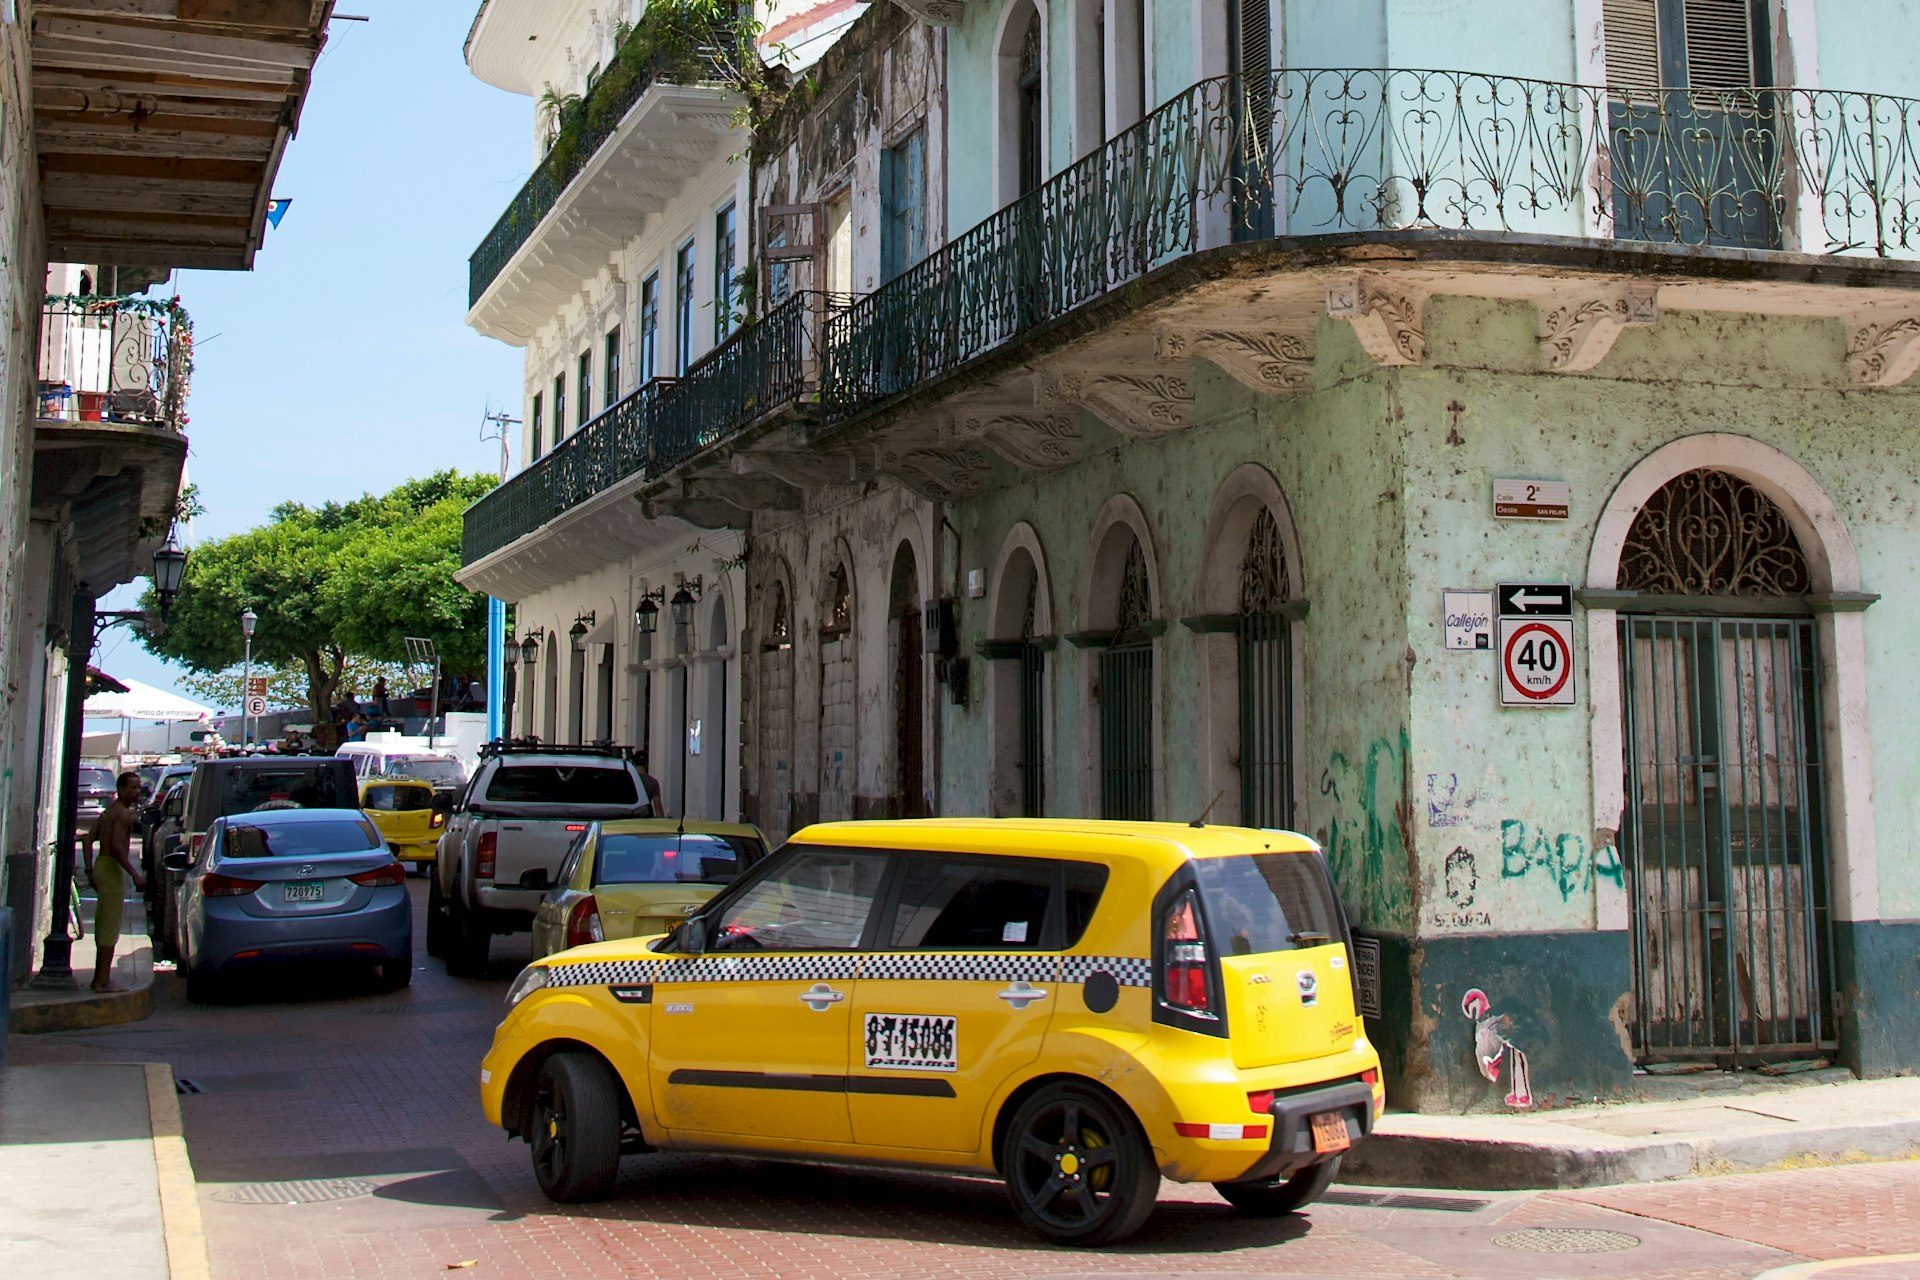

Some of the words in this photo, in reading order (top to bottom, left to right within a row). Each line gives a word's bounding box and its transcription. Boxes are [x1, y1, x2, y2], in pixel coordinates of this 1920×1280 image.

[1497, 505, 1518, 514] Oeste
[1447, 612, 1489, 633] Callejón
[1518, 639, 1557, 671] 40
[1527, 675, 1552, 685] km/h
[253, 701, 261, 711] E
[287, 885, 321, 898] 720975
